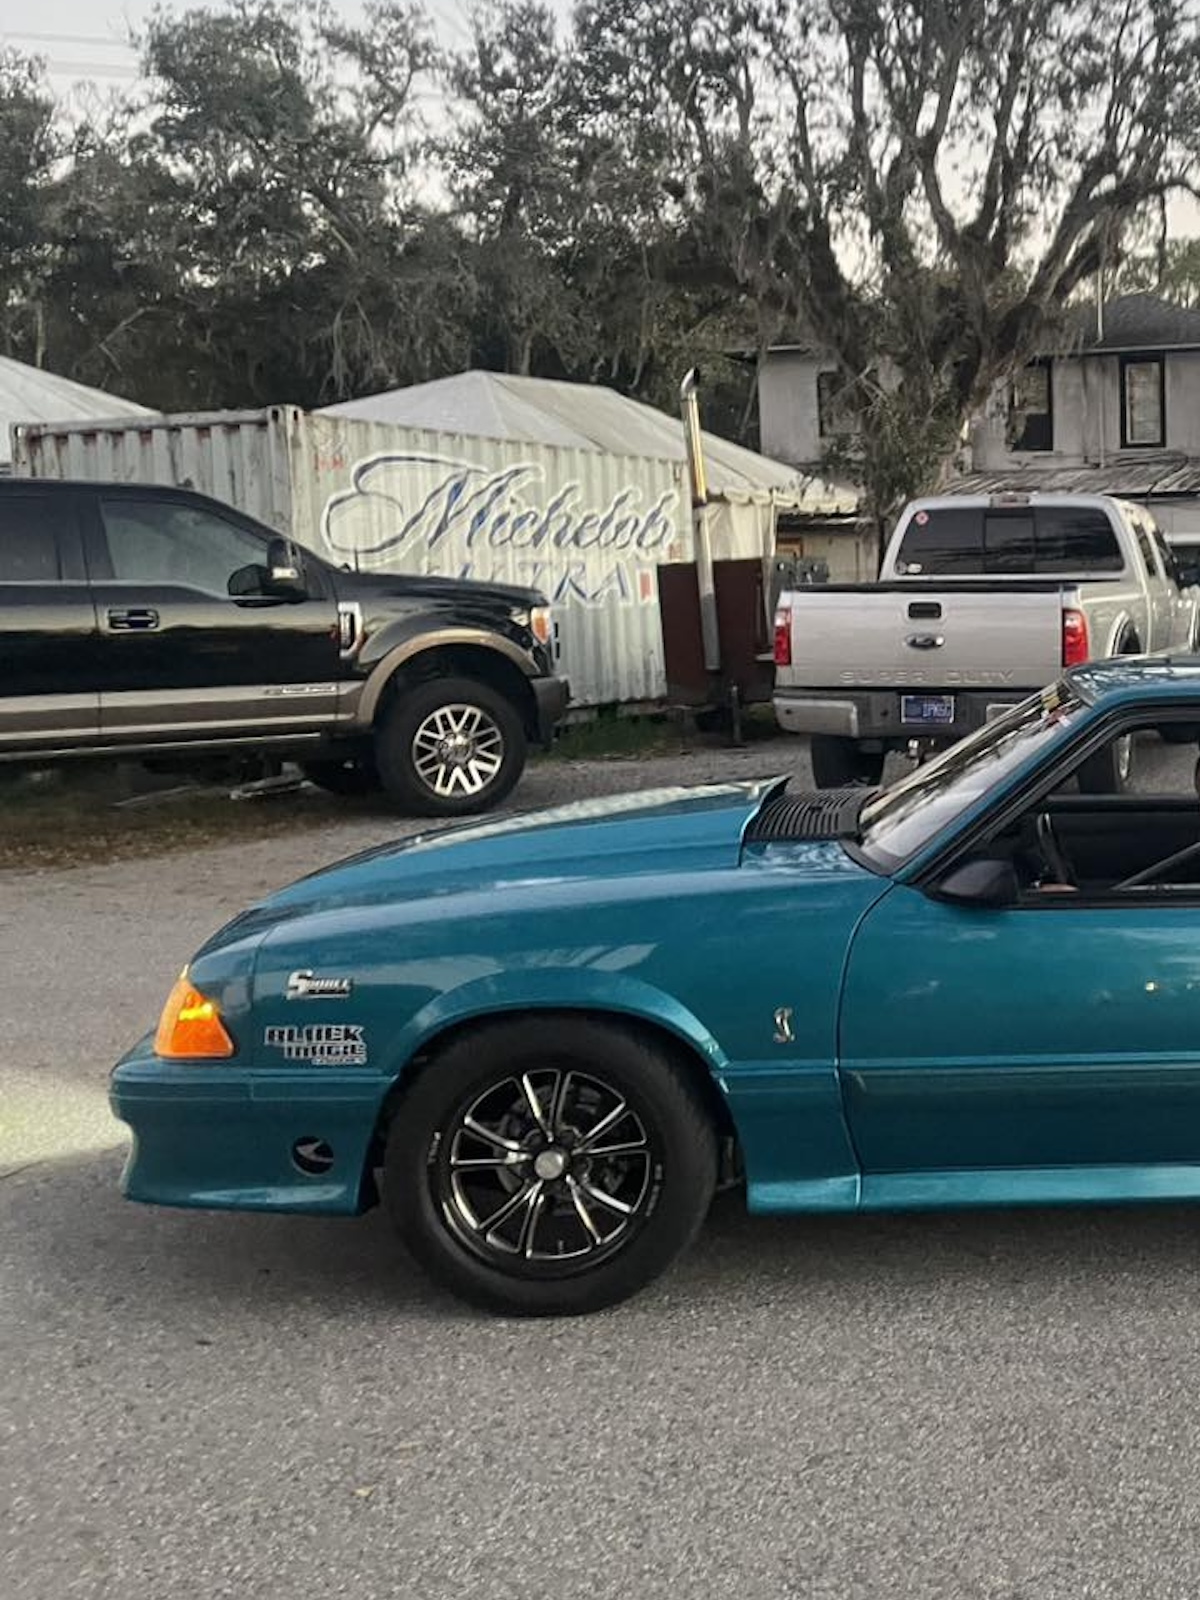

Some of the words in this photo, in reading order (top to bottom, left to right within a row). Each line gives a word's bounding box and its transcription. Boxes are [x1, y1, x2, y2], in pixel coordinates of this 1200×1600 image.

[321, 452, 679, 560] Michelob
[424, 560, 632, 604] TRA
[840, 669, 927, 684] SUPER
[946, 669, 1014, 684] DUTY
